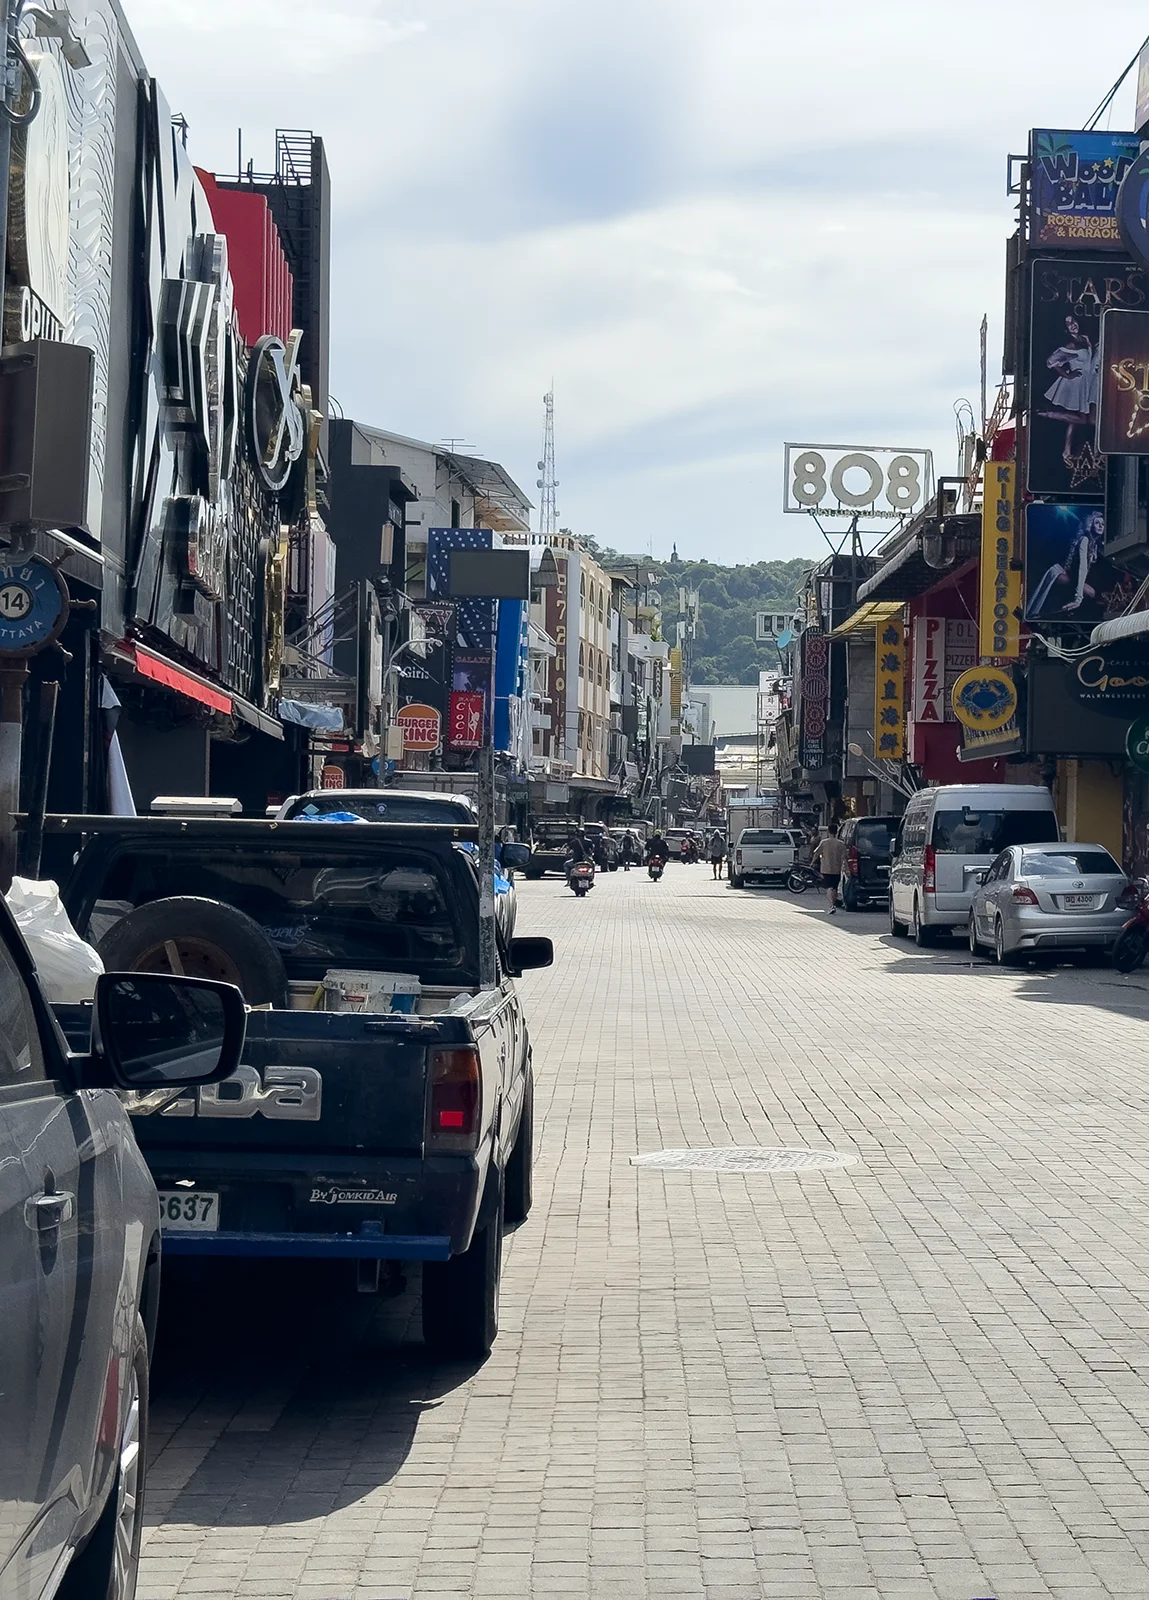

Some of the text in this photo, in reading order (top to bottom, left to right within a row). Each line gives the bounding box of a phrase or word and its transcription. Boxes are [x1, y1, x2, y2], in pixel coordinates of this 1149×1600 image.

[1057, 184, 1117, 210] BAL
[1057, 227, 1120, 239] & KARAOK
[793, 451, 920, 509] 808
[993, 466, 1010, 652] KING SEAFOOD
[2, 592, 24, 610] 14
[921, 619, 940, 721] PIZZA
[398, 718, 438, 728] BURGER
[325, 780, 343, 789] ING
